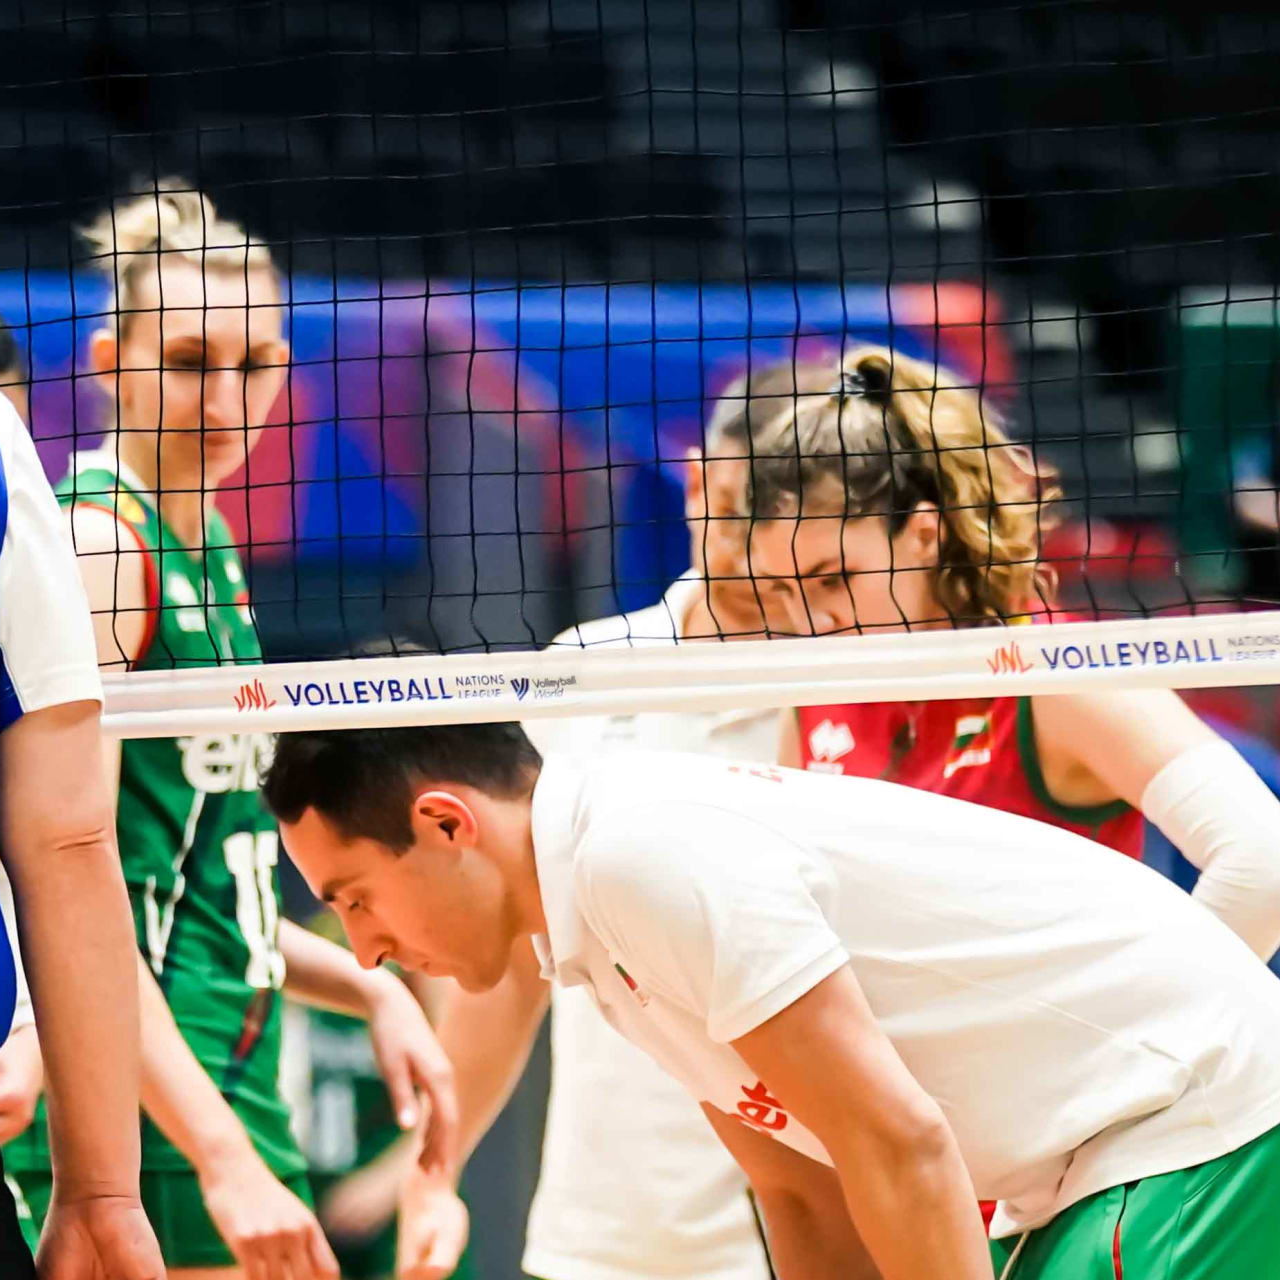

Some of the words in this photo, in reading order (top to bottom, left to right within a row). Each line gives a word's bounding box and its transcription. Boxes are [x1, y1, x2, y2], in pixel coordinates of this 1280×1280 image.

[1040, 638, 1224, 670] VOLLEYBALL
[283, 677, 454, 707] VOLLEYBALL
[455, 674, 505, 686] NATIONS
